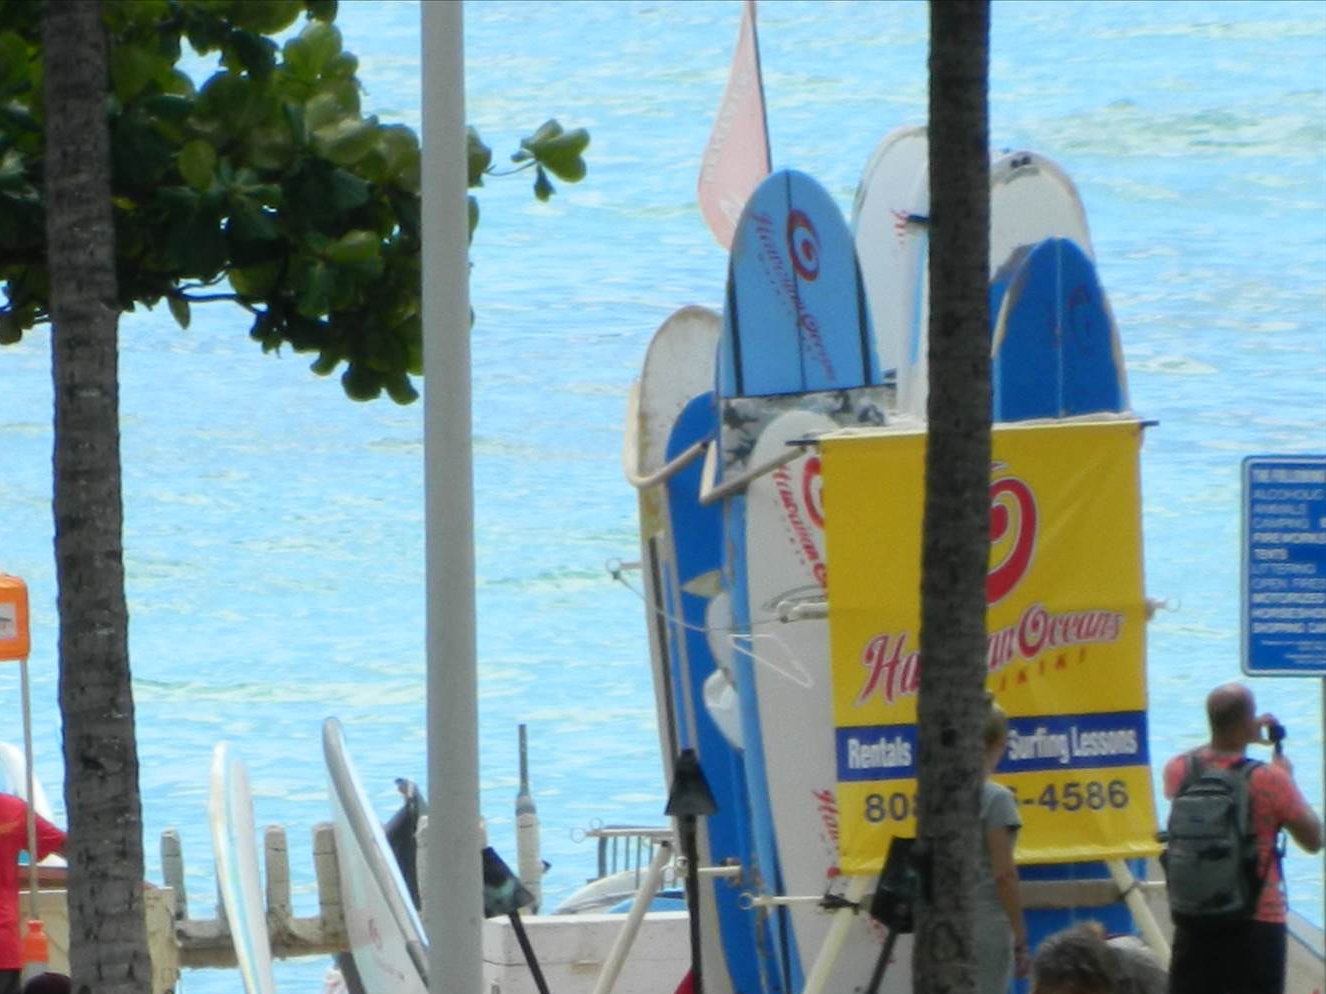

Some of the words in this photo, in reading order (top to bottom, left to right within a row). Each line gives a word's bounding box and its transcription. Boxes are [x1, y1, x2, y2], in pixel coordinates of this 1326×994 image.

[1017, 603, 1123, 658] Oceans
[847, 737, 912, 769] Rentals
[1007, 728, 1069, 763] Surfing
[1071, 726, 1138, 756] Lessons
